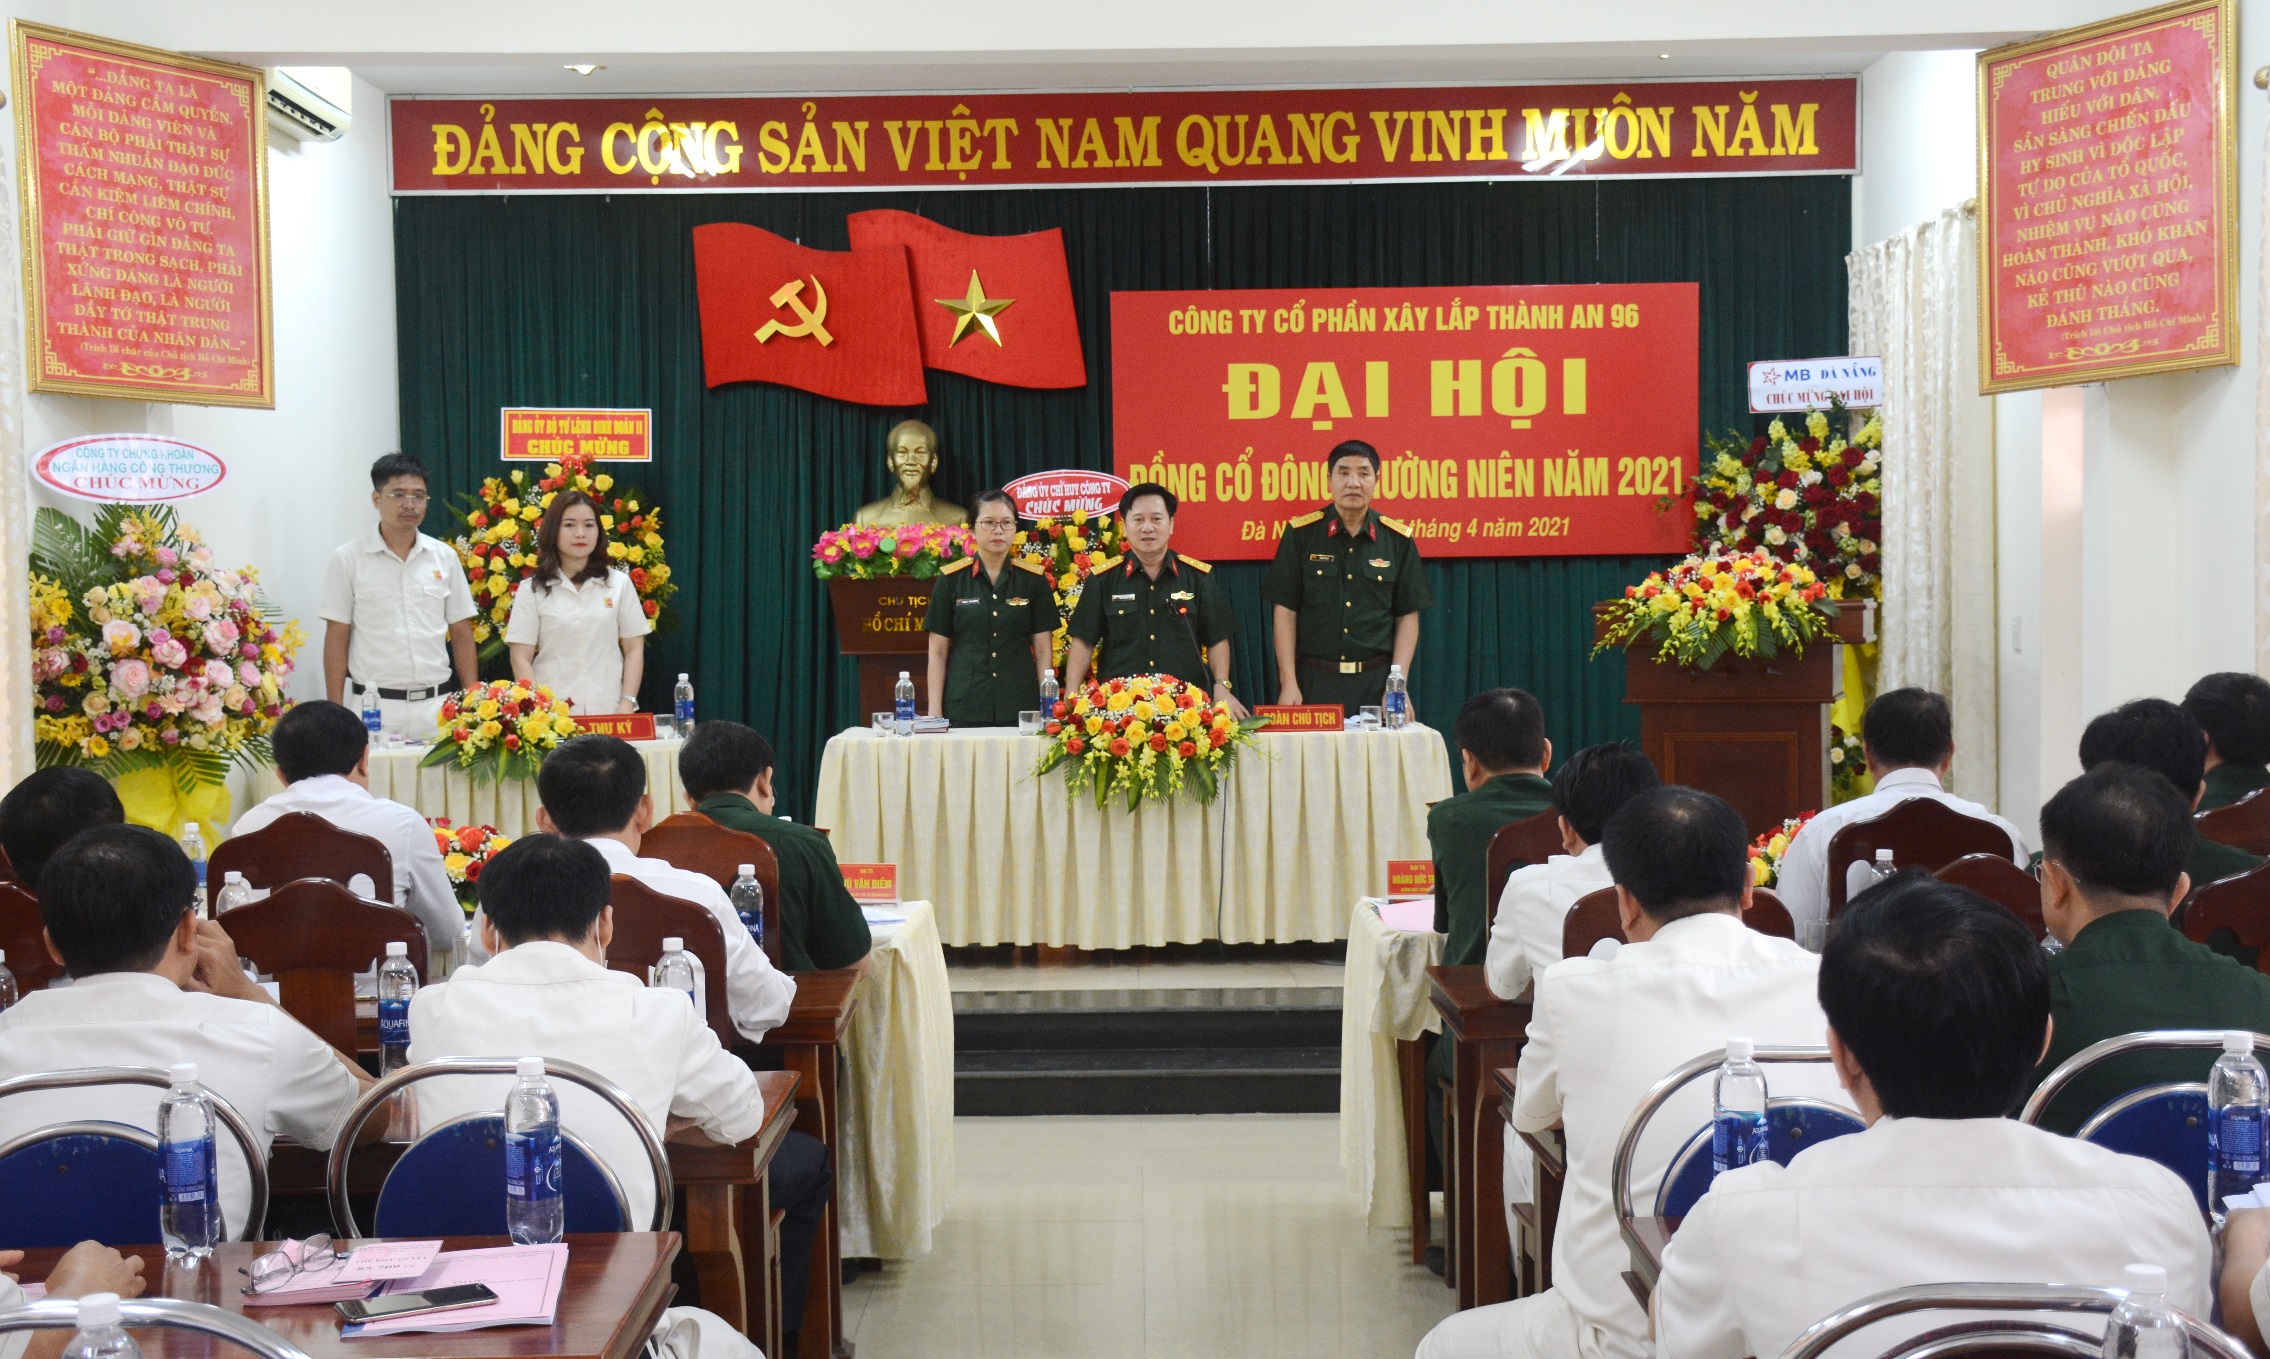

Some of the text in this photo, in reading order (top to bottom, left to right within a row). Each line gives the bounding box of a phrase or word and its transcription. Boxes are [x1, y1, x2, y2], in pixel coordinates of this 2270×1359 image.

[2047, 40, 2152, 78] QUÂN ĐỘI TA
[52, 80, 86, 98] MỘT
[92, 87, 135, 106] ĐẢNG
[155, 81, 174, 93] TA
[179, 84, 197, 98] LÀ
[2031, 60, 2170, 103] TRUNG VỚI ĐẢNG
[2042, 101, 2079, 123] HIẾU
[2086, 94, 2113, 113] VỚI
[109, 109, 150, 128] ĐẢNG
[157, 119, 191, 135] VIÊN
[197, 125, 216, 139] VÀ
[2049, 125, 2089, 144] SÀNG
[2096, 110, 2148, 135] CHIẾN
[2156, 101, 2190, 122] ĐẤU
[60, 121, 230, 163] CÁN BỘ PHẢI THẬT SỰ
[432, 90, 1820, 186] ĐẢNG CỘNG SẢN VIỆT NAM QUANG VINH MUÔN NĂM
[2020, 128, 2183, 173] HY SINH VÌ ĐỘC LẬP
[109, 151, 162, 169] NHUẦN
[168, 161, 198, 176] ĐẠO
[204, 164, 232, 180] ĐỨC
[65, 162, 106, 179] CÁCH
[167, 179, 205, 196] THẬT
[210, 187, 229, 201] SỰ
[2018, 181, 2038, 197] TỰ
[2044, 176, 2064, 191] DO
[2070, 168, 2102, 186] CỦA
[98, 187, 136, 204] KIỆM
[143, 194, 179, 210] LIÊM
[2013, 202, 2029, 219] VÌ
[2034, 195, 2065, 215] CHỦ
[2073, 186, 2123, 208] NGHĨA
[2129, 179, 2149, 198] XÃ
[86, 206, 112, 219] CHÍ
[119, 209, 160, 226] CÔNG
[166, 216, 185, 229] VÔ
[1169, 298, 1639, 334] CÔNG TY CỔ PHẦN XÂY LẮP THÀNH AN 96
[2047, 309, 2091, 326] ĐÁNH
[1784, 369, 1810, 381] MB
[1222, 347, 1586, 431] ĐẠI HỘI
[1766, 390, 1794, 404] CHÚC
[1797, 389, 1827, 403] MỪNG
[76, 446, 105, 459] CÔNG
[108, 448, 120, 459] TY
[527, 435, 629, 455] CHÚC MỪNG
[53, 461, 219, 474] NGÂN HÀNG CÔNG THƯƠNG
[1216, 447, 1253, 502] CỔ
[1373, 450, 1458, 499] ƯỜNG
[1467, 451, 1534, 498] NIÊN
[1543, 449, 1608, 496] NĂM
[1617, 456, 1682, 496] 2021
[74, 473, 199, 489] CHÚC MỪNG
[1065, 483, 1079, 496] HUY
[1080, 480, 1101, 495] CÔNG
[1101, 482, 1111, 493] TY
[1025, 496, 1103, 514] CHÚC MỪNG
[1241, 520, 1265, 540] Đà
[1410, 518, 1462, 542] tháng
[1466, 519, 1477, 536] 4
[1483, 517, 1522, 537] năm
[1528, 516, 1570, 536] 2021
[884, 612, 911, 632] CHÍ
[1292, 709, 1312, 725] CHỦ
[1314, 712, 1336, 727] TỊCH
[381, 1018, 409, 1029] AQUAFIN
